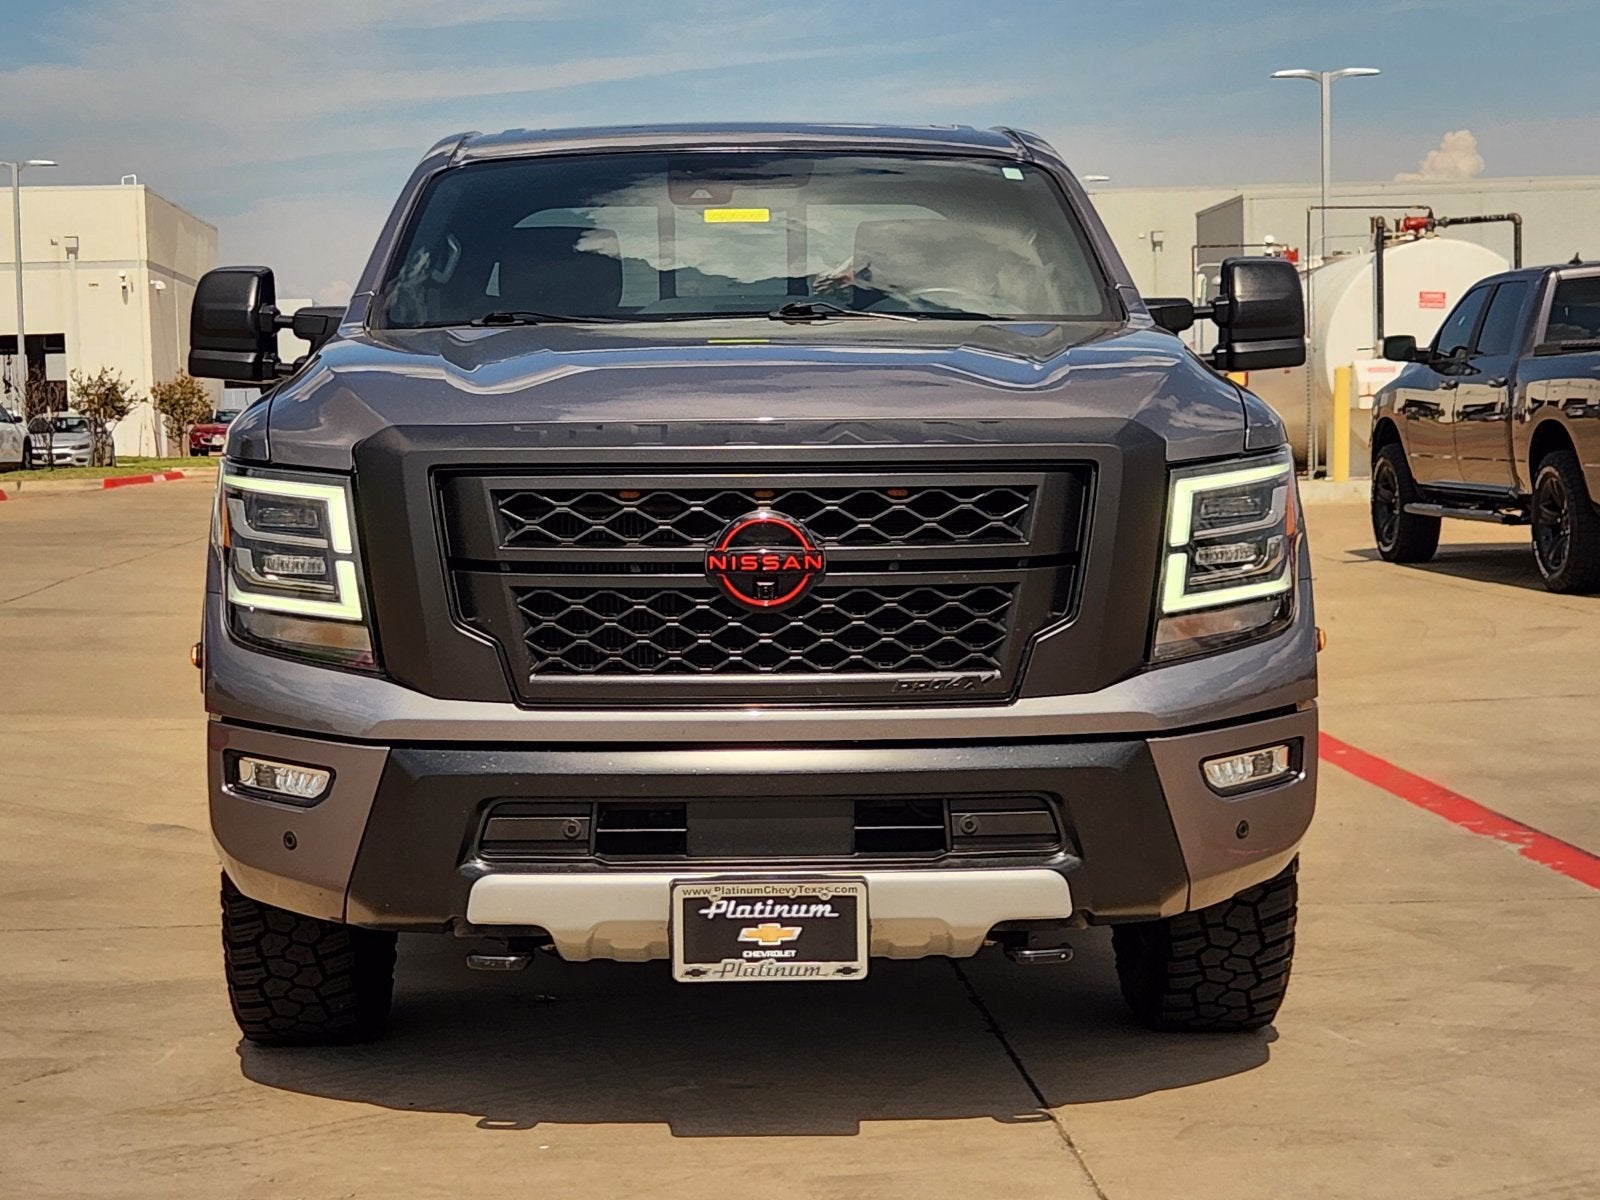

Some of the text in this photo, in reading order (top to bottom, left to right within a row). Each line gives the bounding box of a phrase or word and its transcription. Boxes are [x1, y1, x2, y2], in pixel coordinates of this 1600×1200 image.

[708, 555, 823, 571] NISSAN
[682, 885, 858, 896] wwwPlatinumChevyTexas.com
[698, 900, 840, 919] Platinum
[742, 950, 797, 958] CHEVROLET
[713, 962, 829, 978] Platinum
